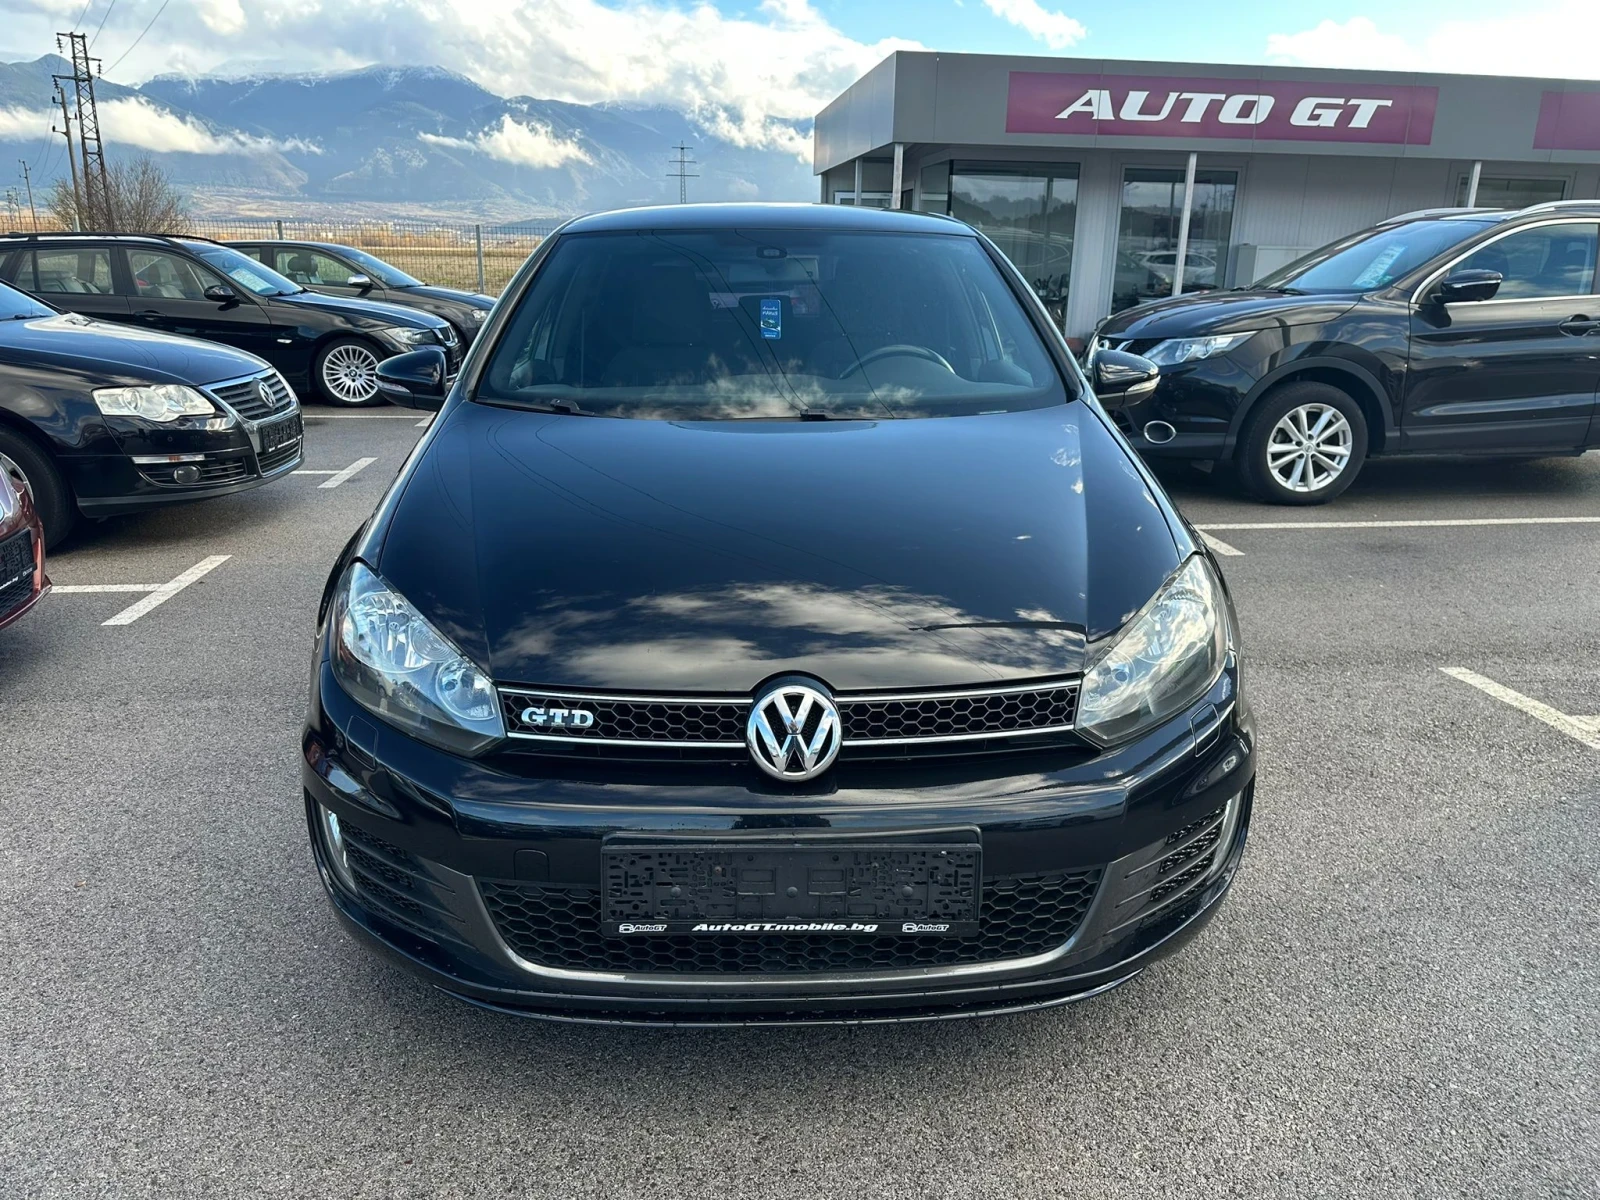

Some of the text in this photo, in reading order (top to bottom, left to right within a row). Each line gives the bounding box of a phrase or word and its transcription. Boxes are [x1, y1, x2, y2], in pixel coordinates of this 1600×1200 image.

[1054, 89, 1393, 129] AUTO GT
[520, 706, 594, 728] GTD
[634, 924, 667, 932] AutoGT
[691, 922, 878, 933] AutoGT.mobile.bg
[916, 923, 949, 932] AutoGT
